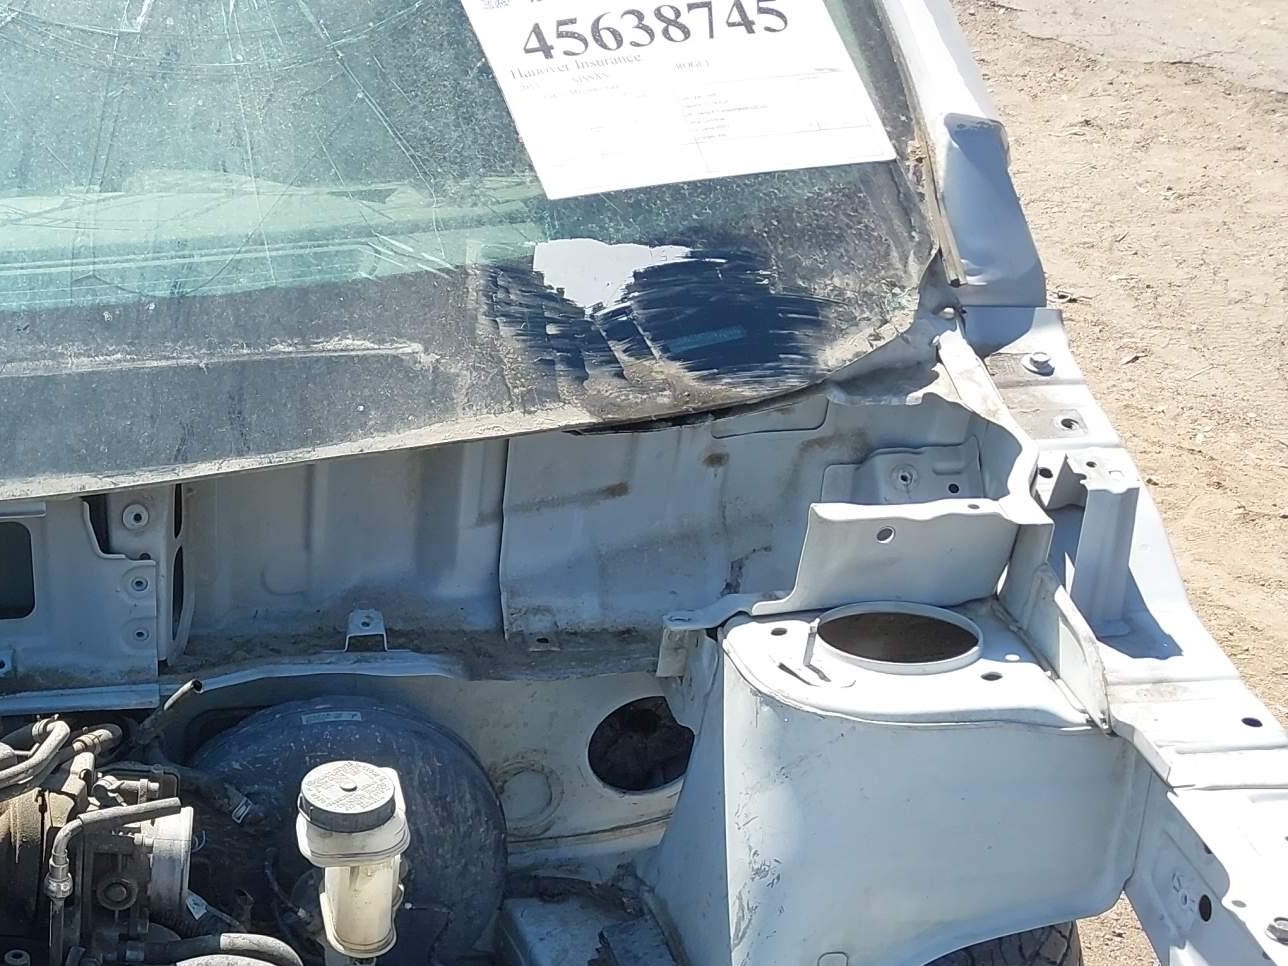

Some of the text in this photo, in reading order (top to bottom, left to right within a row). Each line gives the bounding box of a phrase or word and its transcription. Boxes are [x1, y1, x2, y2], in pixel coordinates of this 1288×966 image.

[523, 0, 789, 60] 45638745
[510, 53, 642, 80] Hanover Insurance
